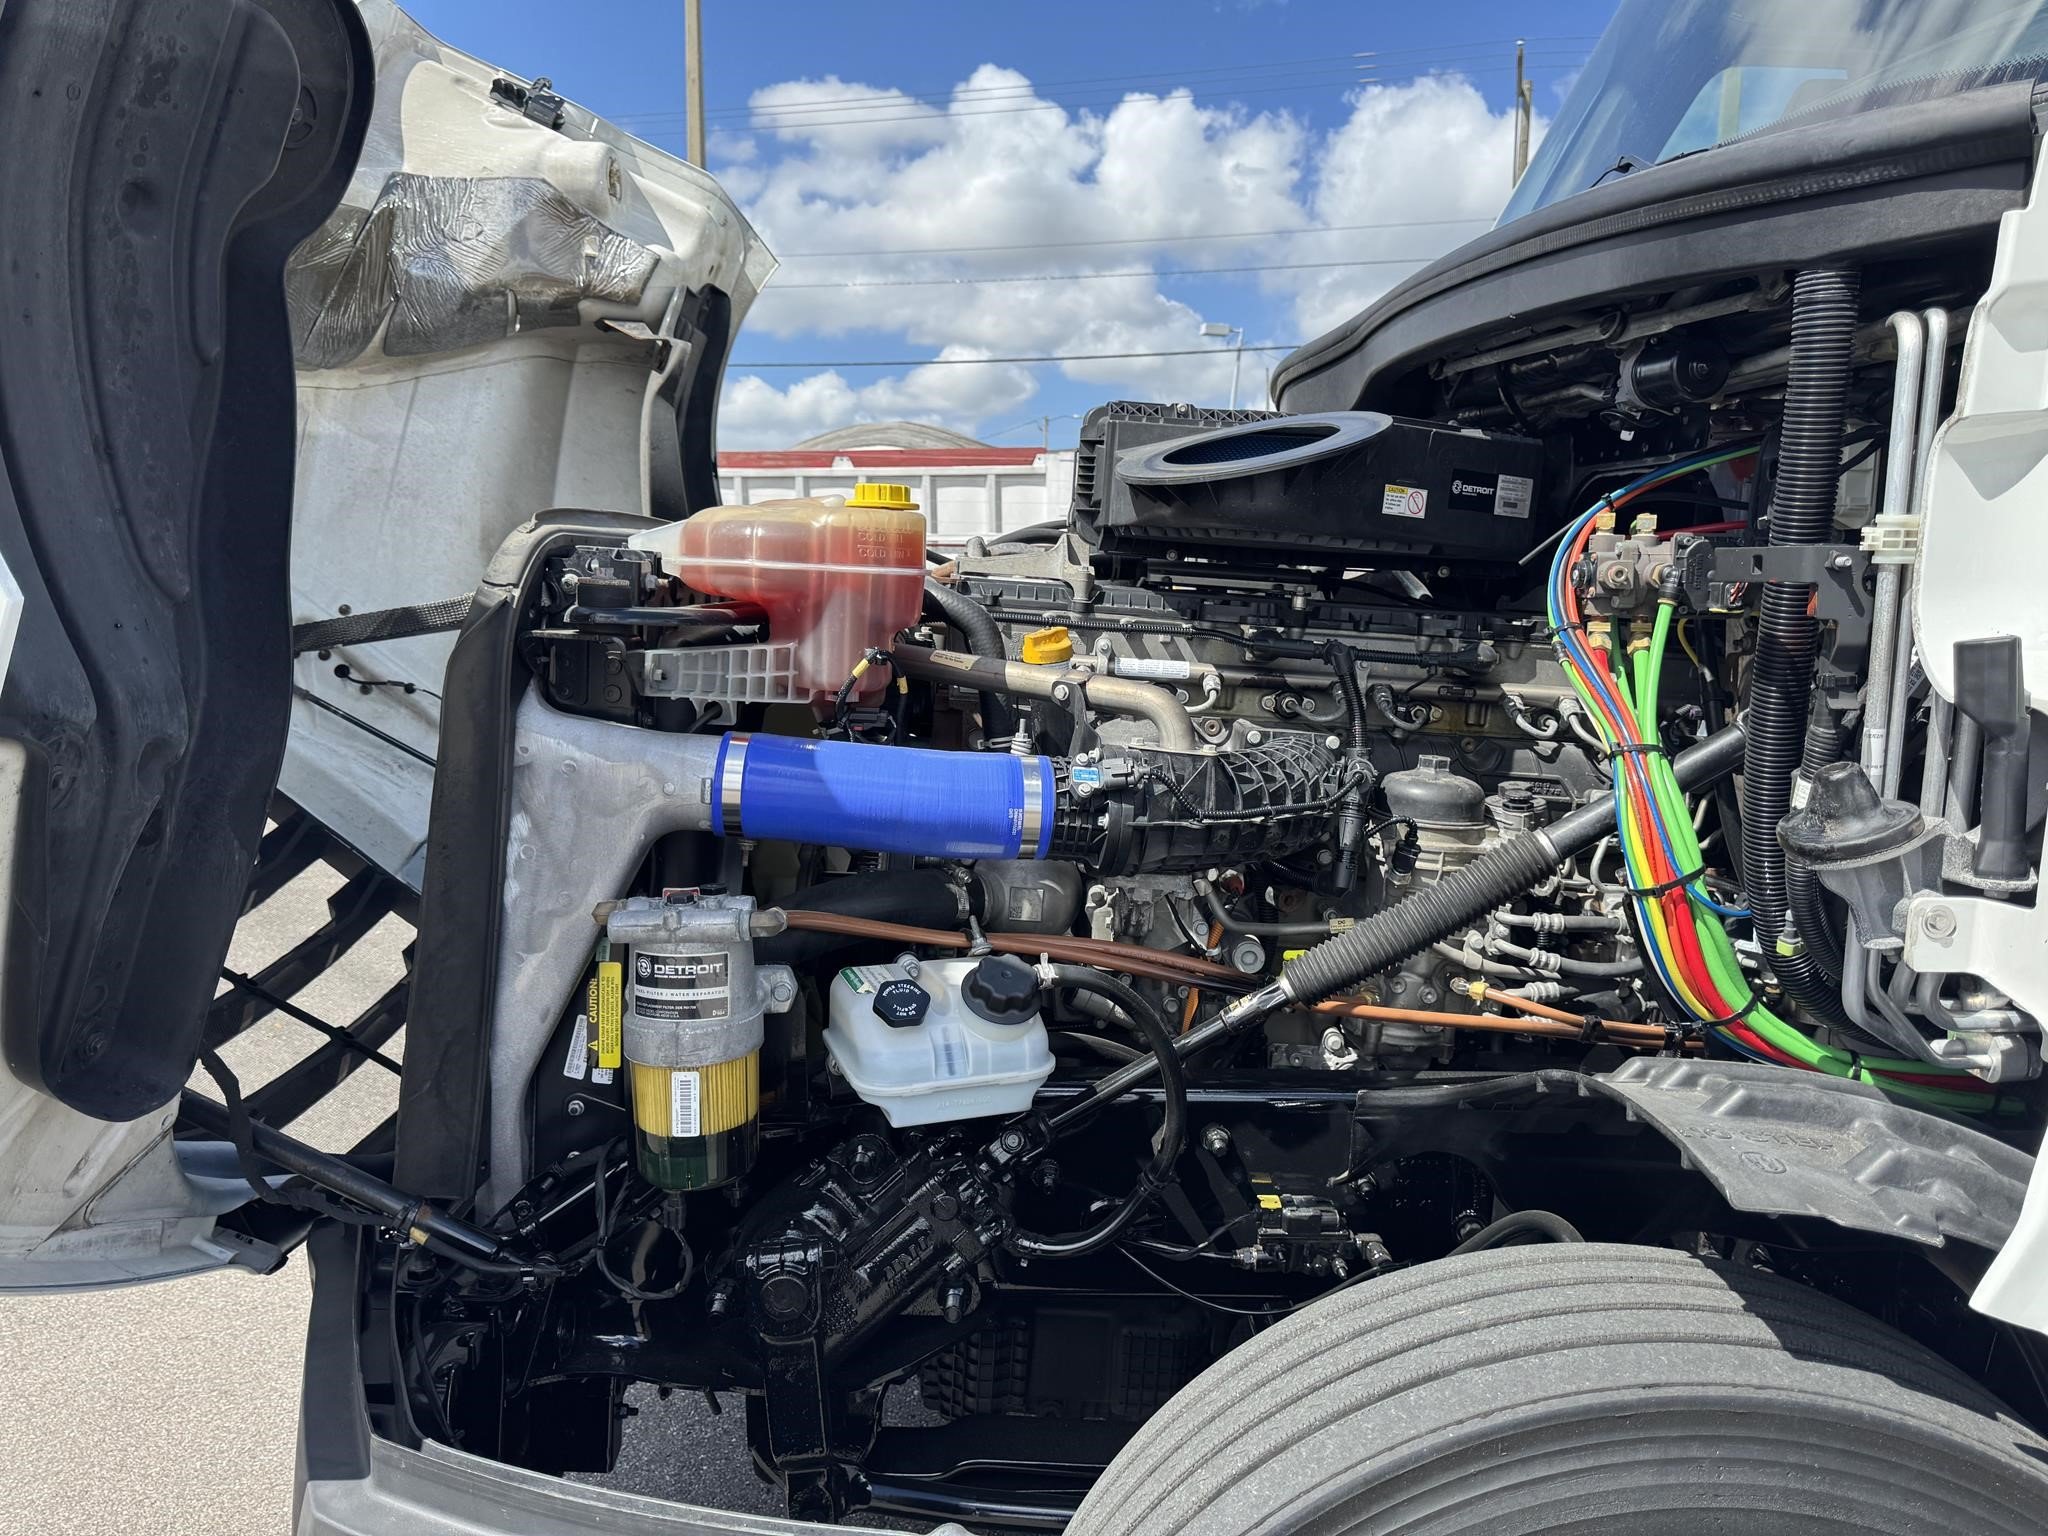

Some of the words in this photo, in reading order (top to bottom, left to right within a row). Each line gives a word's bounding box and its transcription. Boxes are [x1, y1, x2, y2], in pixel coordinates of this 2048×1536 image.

[1462, 484, 1495, 495] DETROIT
[654, 963, 723, 974] DETROIT
[882, 985, 895, 996] POWER
[897, 984, 921, 994] STEERING
[589, 978, 597, 1023] CAUTION:
